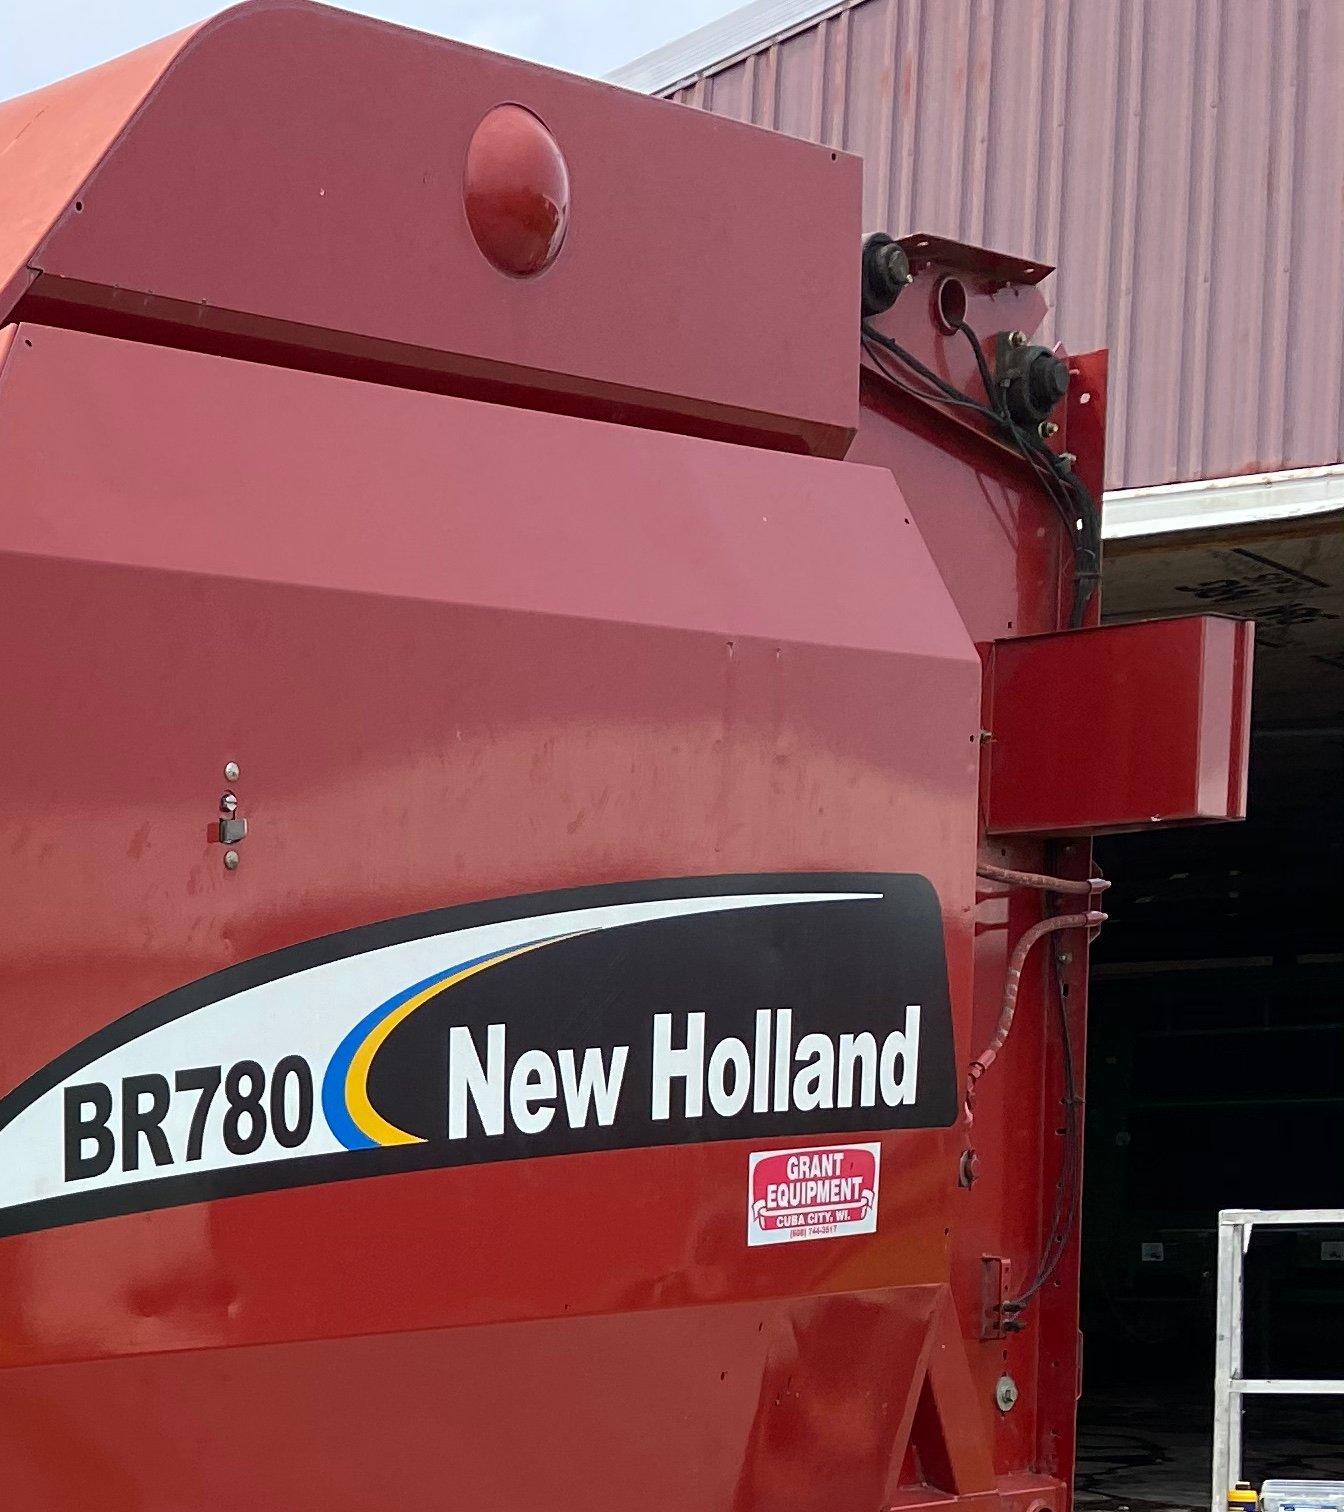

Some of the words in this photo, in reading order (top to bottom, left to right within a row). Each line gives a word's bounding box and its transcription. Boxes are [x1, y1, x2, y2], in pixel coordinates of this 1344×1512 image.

[61, 1054, 310, 1183] BR780
[447, 1022, 629, 1140] New
[651, 1005, 922, 1122] Holland
[786, 1152, 845, 1181] GRANT
[767, 1176, 864, 1209] EQUIPMENT
[776, 1213, 806, 1228] CUBA
